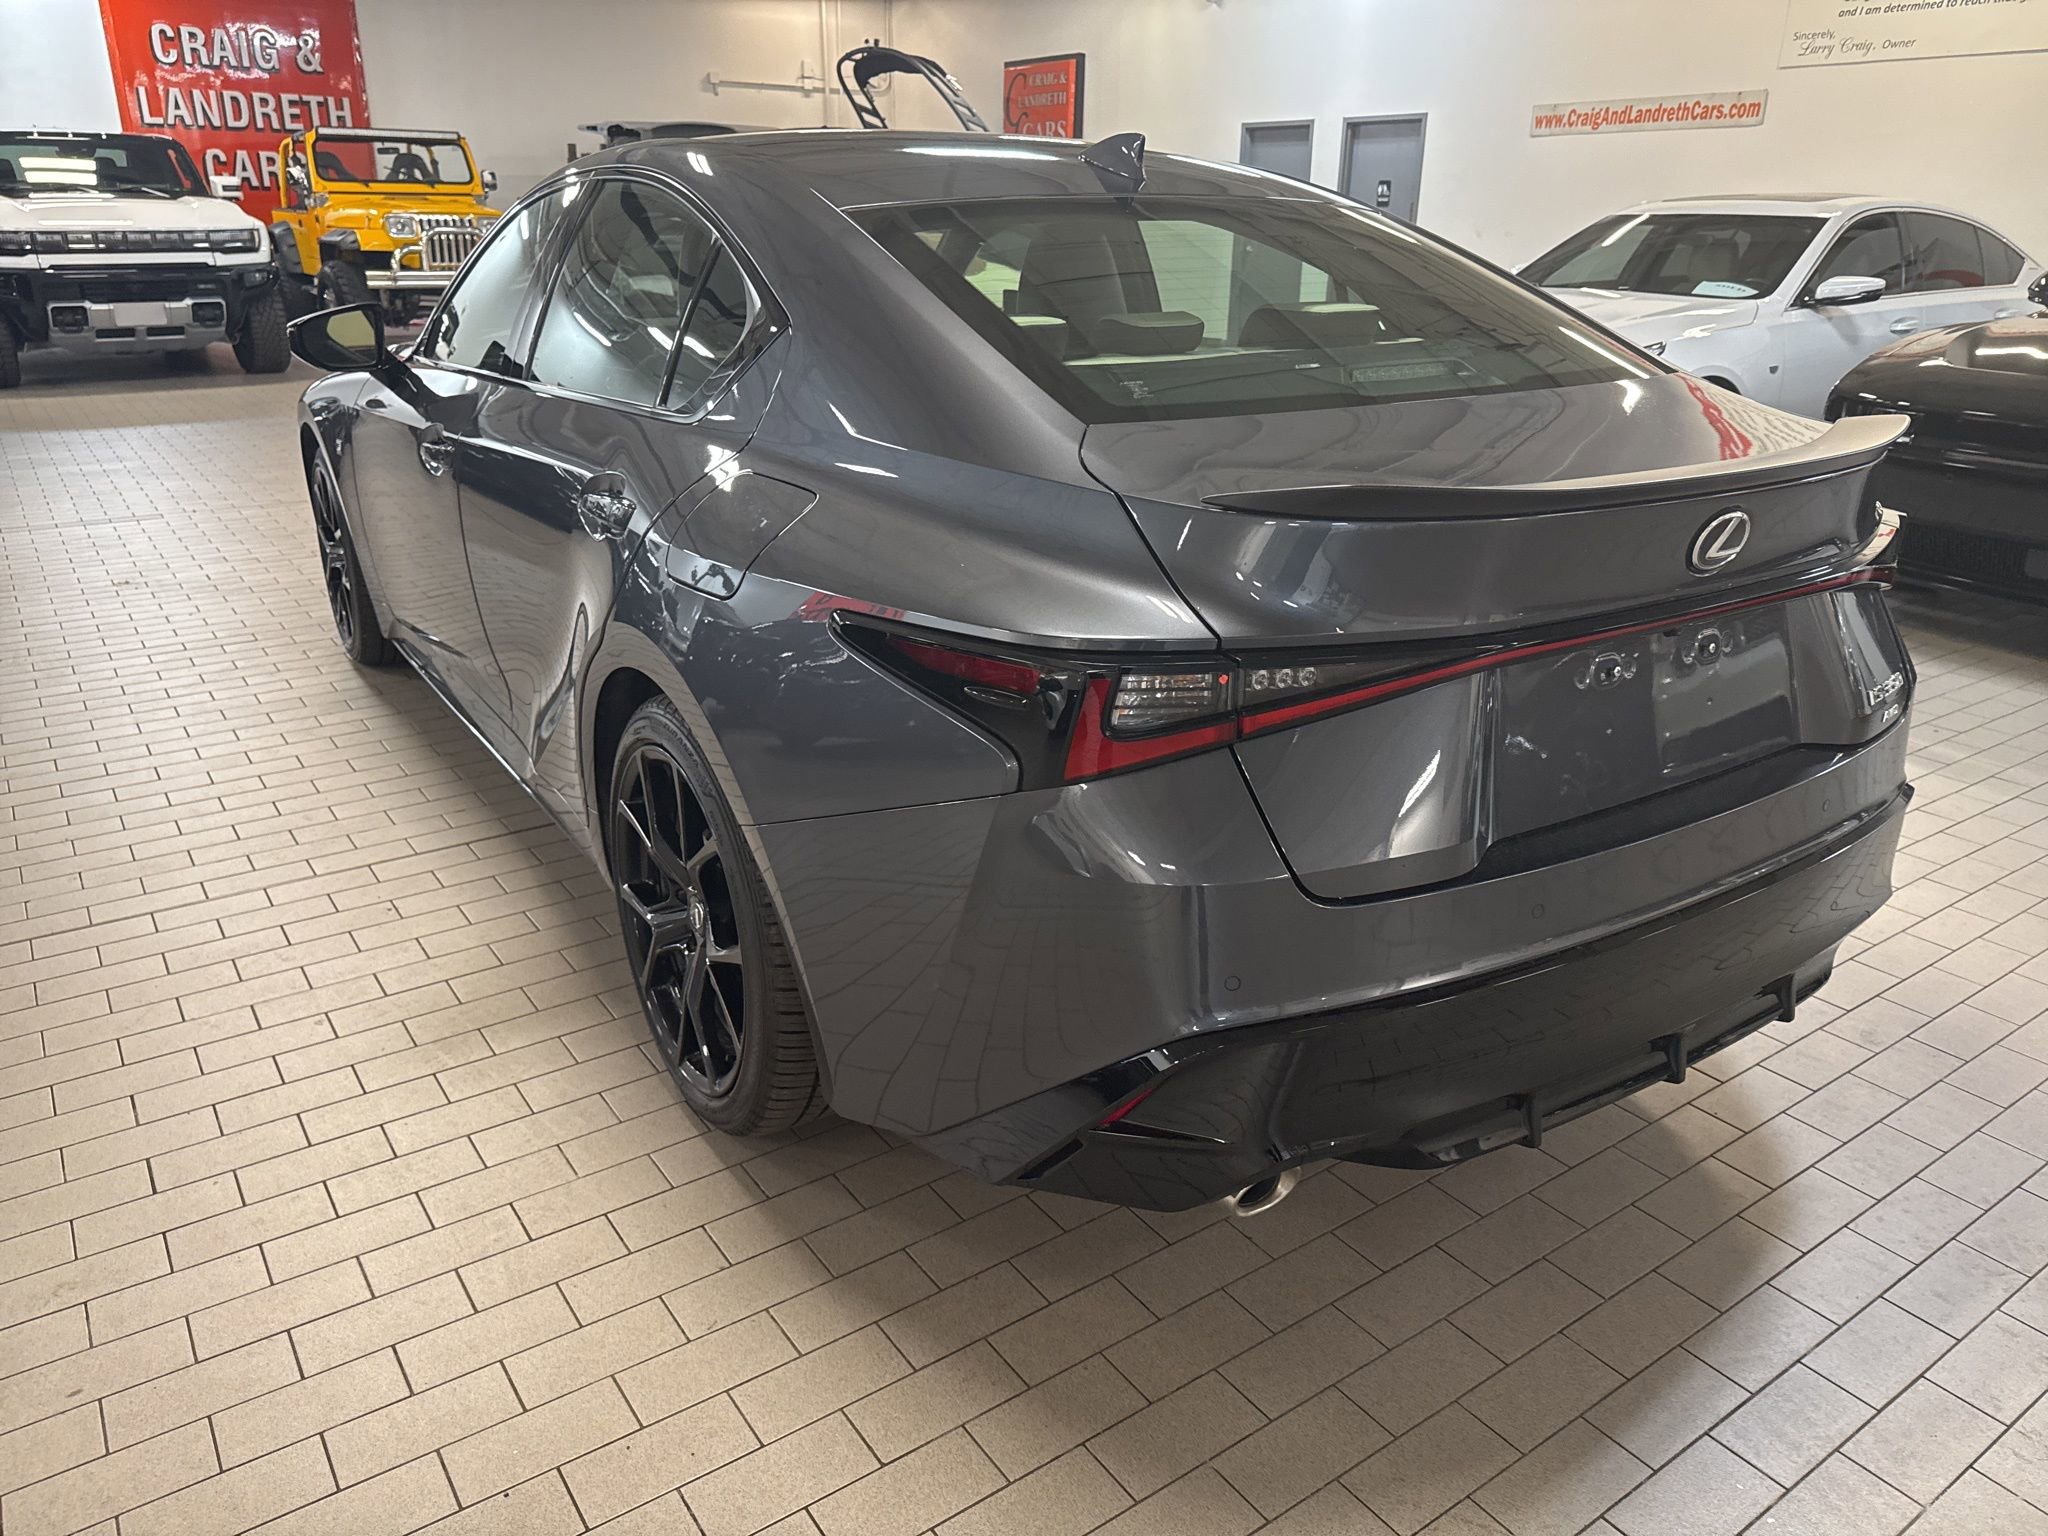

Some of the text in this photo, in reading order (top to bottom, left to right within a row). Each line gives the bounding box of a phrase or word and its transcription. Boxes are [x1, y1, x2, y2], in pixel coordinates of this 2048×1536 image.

[1838, 6, 1858, 17] and
[1859, 6, 1864, 16] I
[1865, 6, 1881, 15] am
[1883, 0, 1944, 13] determined
[151, 22, 324, 73] CRAIG &
[1793, 29, 1836, 41] Sincerely,
[1798, 40, 1835, 59] Larry
[1882, 39, 1917, 49] Owner
[136, 85, 353, 131] LANDRETH
[1535, 100, 1762, 131] www.CraigAndLandrethCars.com
